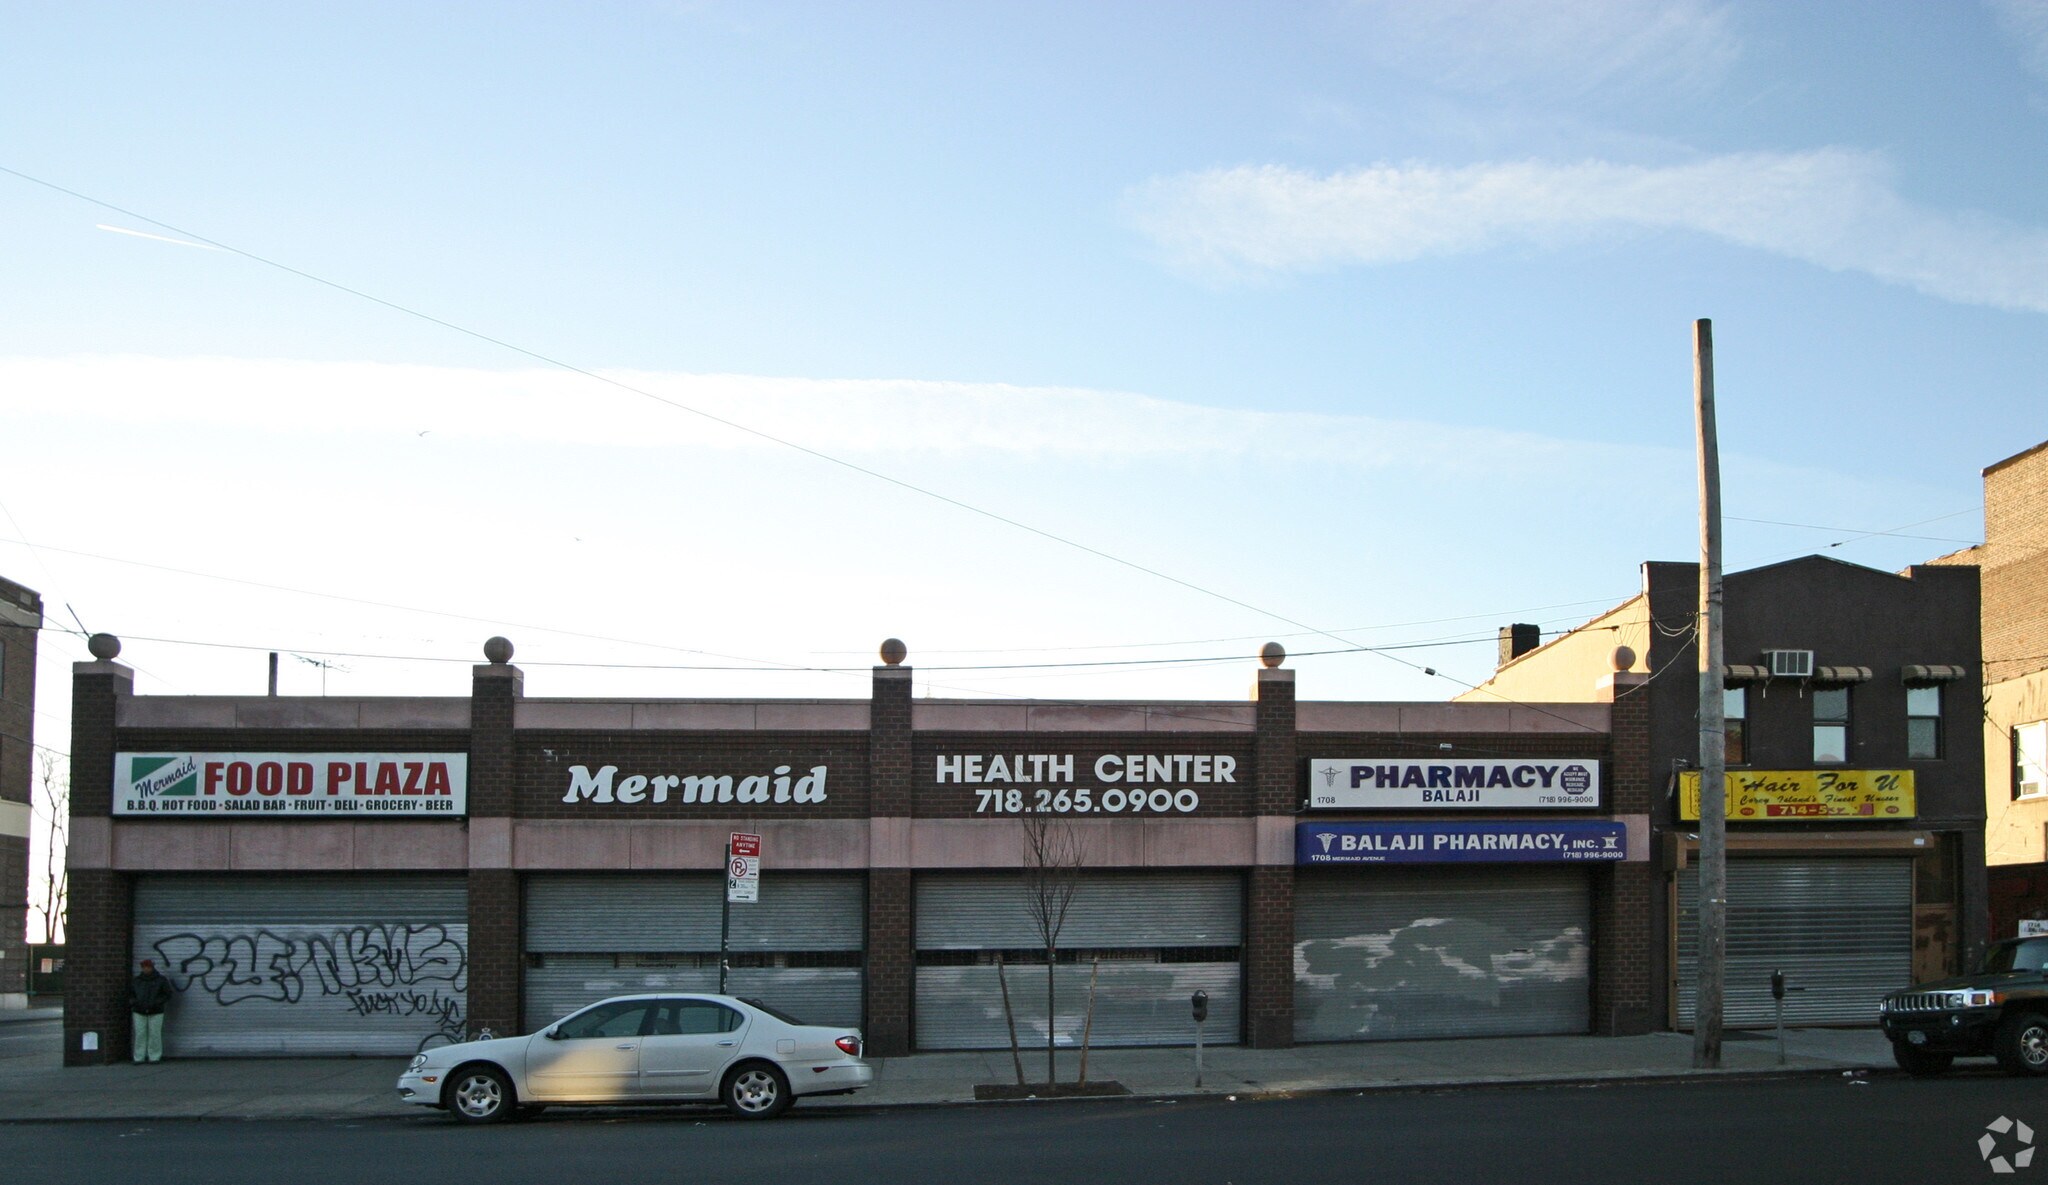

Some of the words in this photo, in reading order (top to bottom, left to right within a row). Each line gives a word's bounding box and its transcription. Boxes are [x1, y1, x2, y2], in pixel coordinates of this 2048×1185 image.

[134, 756, 197, 799] Mermaid
[204, 761, 315, 796] FOOD
[326, 761, 452, 796] PLAZA
[936, 754, 1074, 783] HEALTH
[1094, 753, 1237, 783] CENTER
[1350, 765, 1560, 789] PHARMACY
[562, 765, 828, 804] Mermaid
[1739, 775, 1801, 792] Hair
[1817, 772, 1859, 792] For
[1874, 774, 1900, 791] U
[127, 800, 159, 812] B.B.Q.
[162, 799, 185, 811] HOT
[187, 799, 217, 811] FOOD
[224, 799, 260, 811] SALAD
[263, 799, 287, 811] BAR
[294, 799, 326, 811] FRUIT
[334, 799, 358, 811] DELI
[365, 799, 418, 811] GROCERY
[425, 799, 453, 811] BEER
[975, 788, 1200, 813] 718.265.0900
[1317, 796, 1336, 804] 1708
[1422, 790, 1480, 802] BALAJI
[1538, 796, 1556, 804] (718)
[1557, 796, 1594, 804] 996-9000
[1341, 834, 1424, 850] BALAJI
[1433, 833, 1569, 851] PHARMACY,
[1572, 839, 1599, 849] INC.
